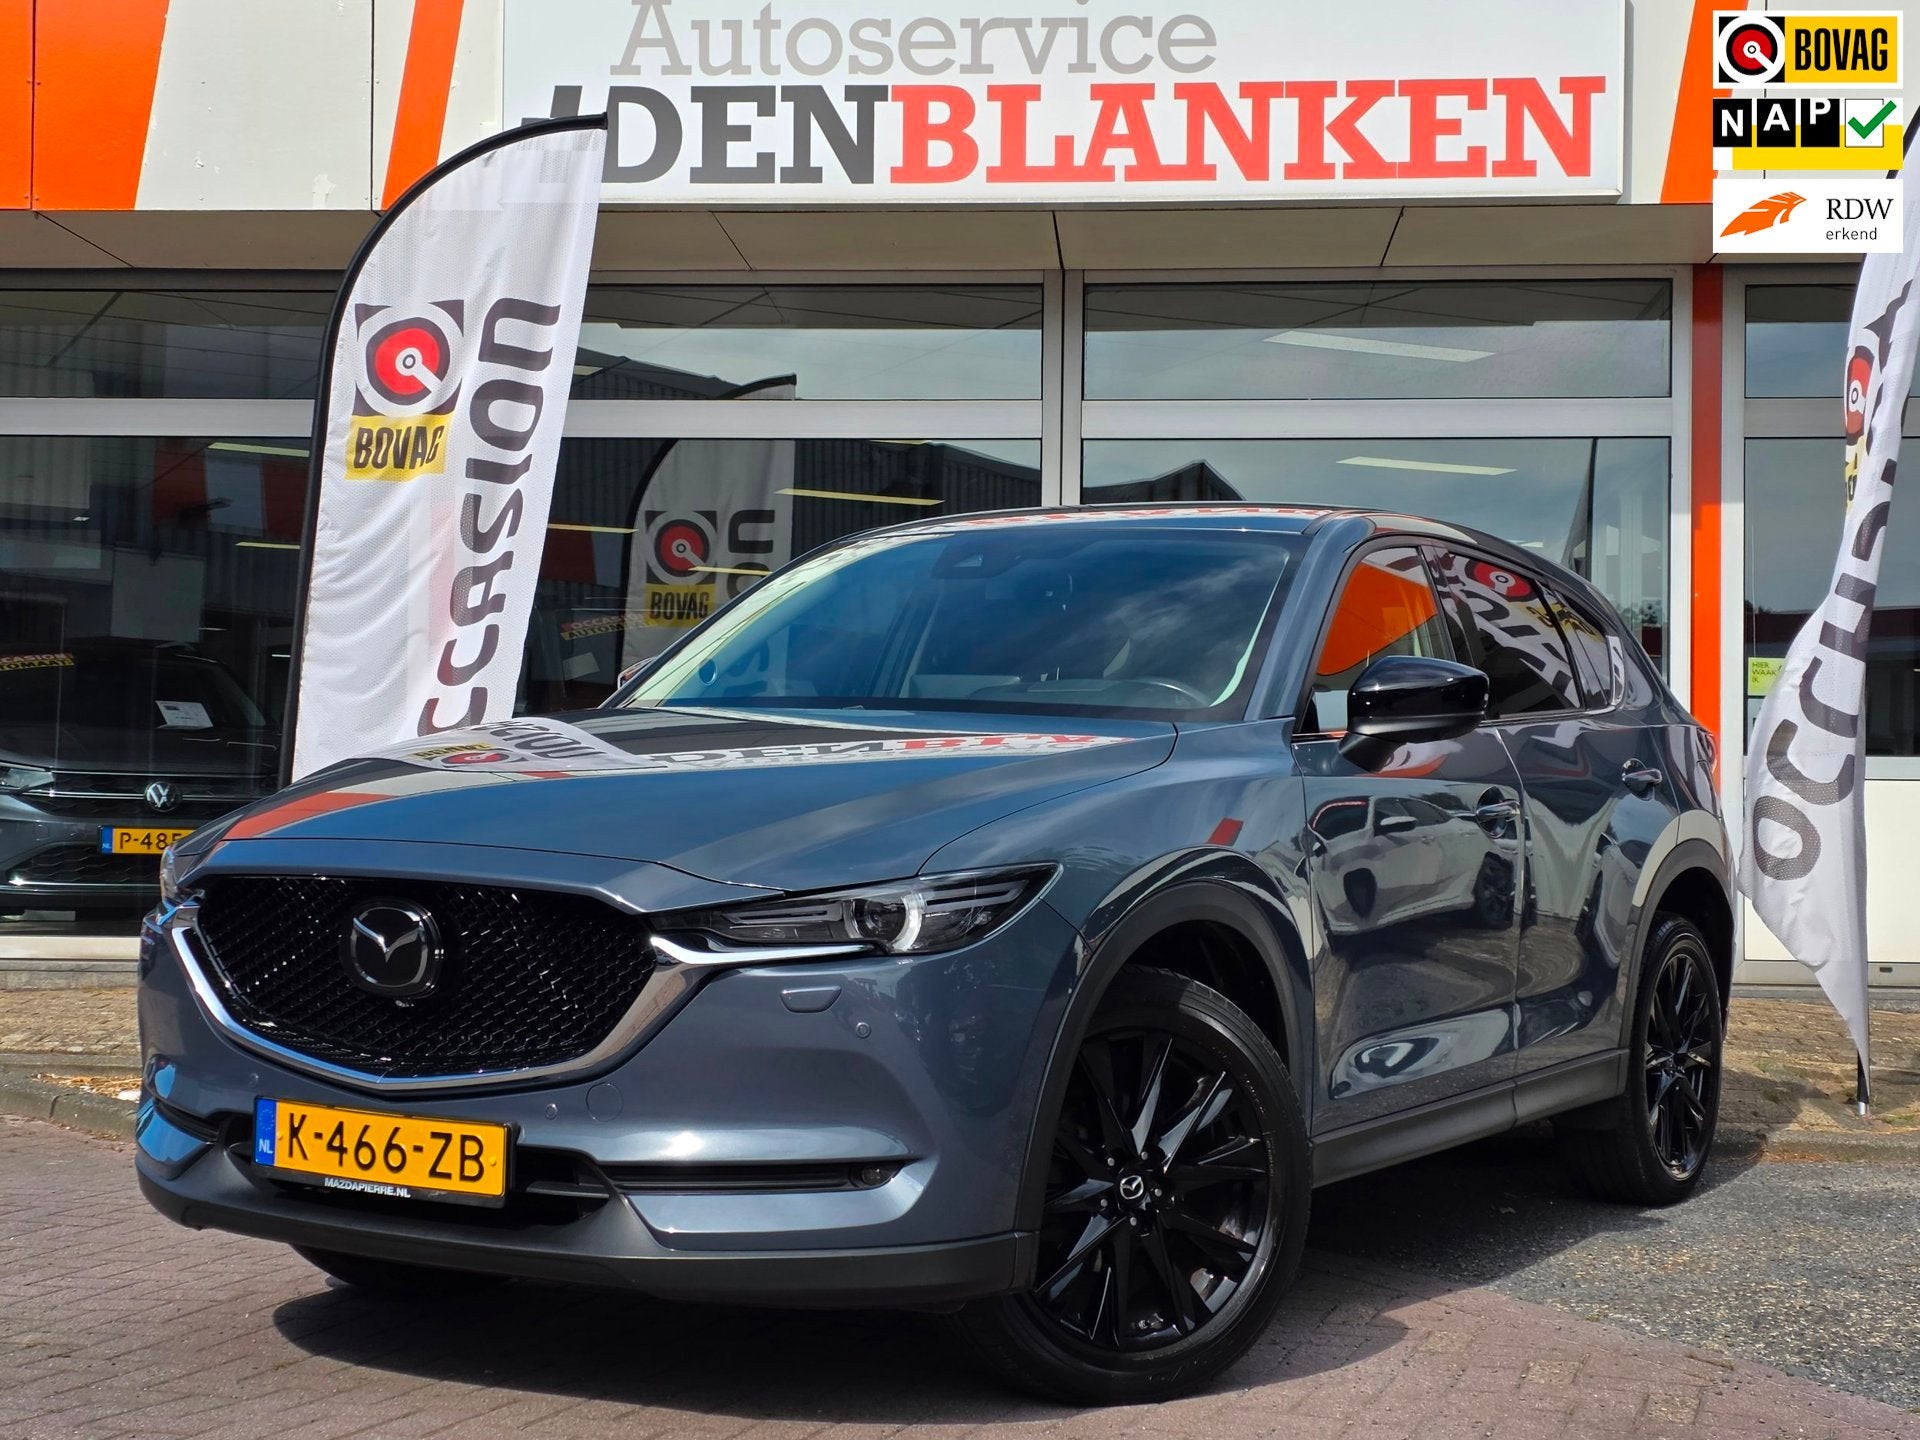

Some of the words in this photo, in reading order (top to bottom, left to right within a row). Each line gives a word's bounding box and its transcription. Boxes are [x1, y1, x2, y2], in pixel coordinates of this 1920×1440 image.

[609, 0, 1217, 76] Autoservice
[353, 424, 445, 471] BOVAG
[650, 591, 710, 620] BOVAG
[258, 1138, 274, 1154] NL
[287, 1112, 485, 1183] K-466-ZB
[324, 1177, 411, 1198] MAZDAPIERRE.NL
